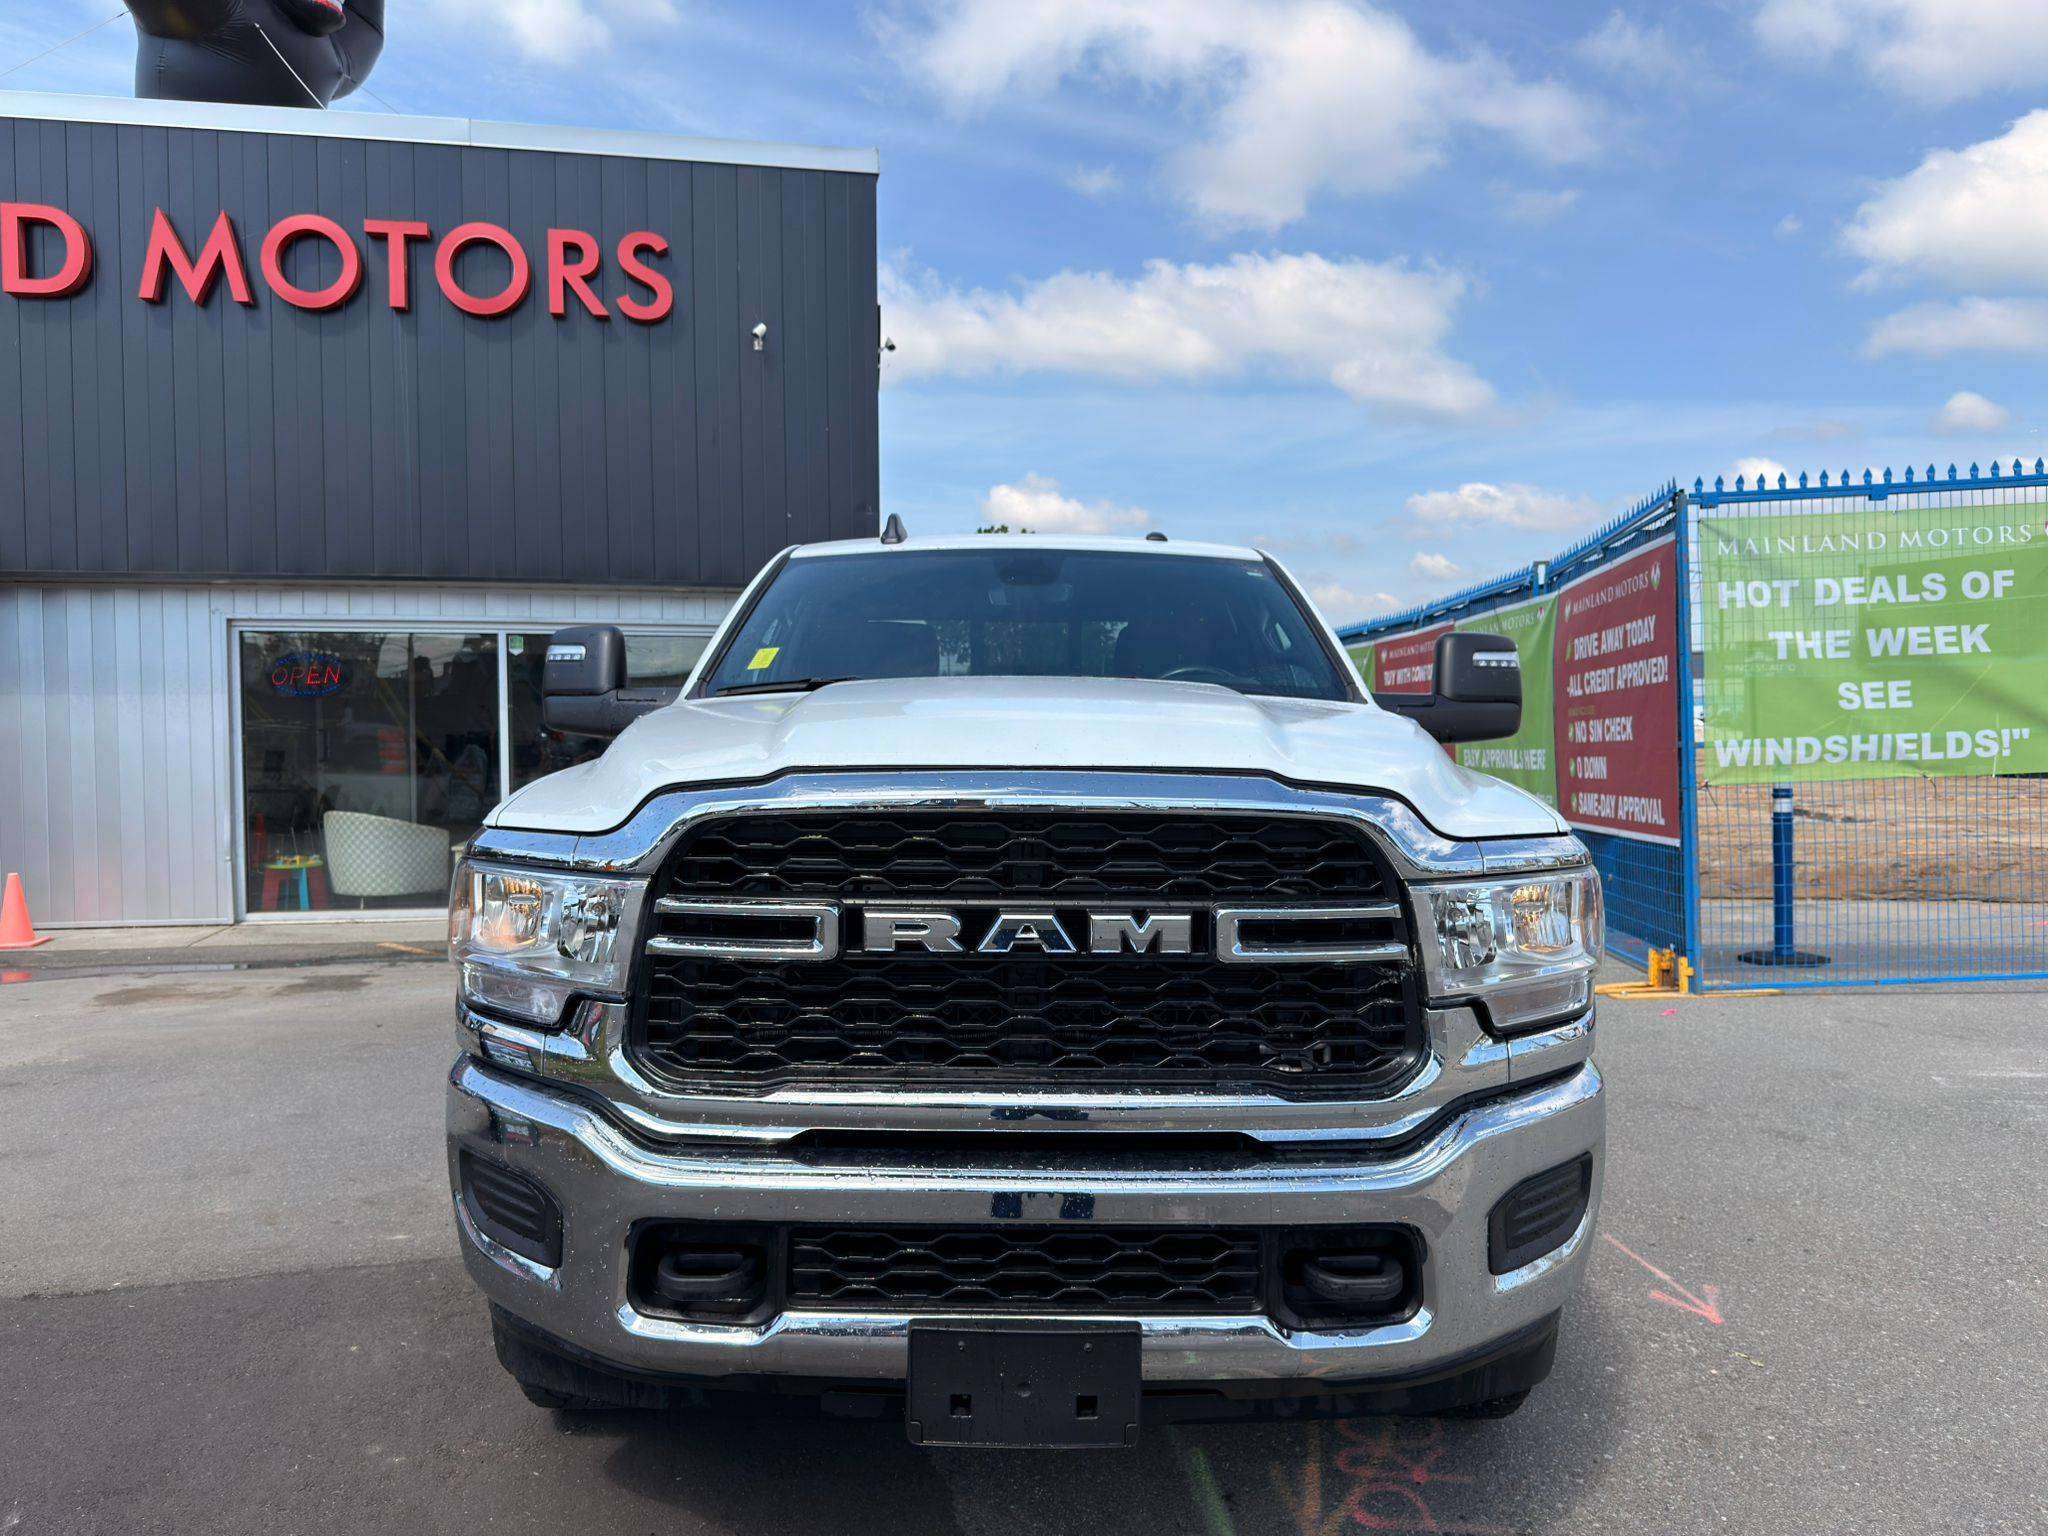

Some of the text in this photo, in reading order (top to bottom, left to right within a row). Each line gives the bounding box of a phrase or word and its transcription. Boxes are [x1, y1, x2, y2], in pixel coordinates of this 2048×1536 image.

[137, 206, 675, 324] MOTORS
[1717, 524, 2032, 556] MAINLAND MOTORS
[1573, 571, 1649, 615] MAINLAND MOTORS
[1718, 569, 2015, 609] HOT DEALS OF
[1574, 614, 1656, 660] DRIVE AWAY TODAY
[1768, 623, 1992, 660] THE WEEK
[271, 665, 342, 687] OPEN
[1584, 666, 1616, 694] CREDIT
[1617, 655, 1669, 690] APPROVED!
[1838, 680, 1913, 710] SEE
[1575, 716, 1634, 743] NO SIN CHECK
[1583, 757, 1607, 779] DOWN
[1578, 792, 1616, 818] SAME-DAY
[1617, 796, 1665, 825] APPROVAL
[863, 909, 1192, 953] RAM
